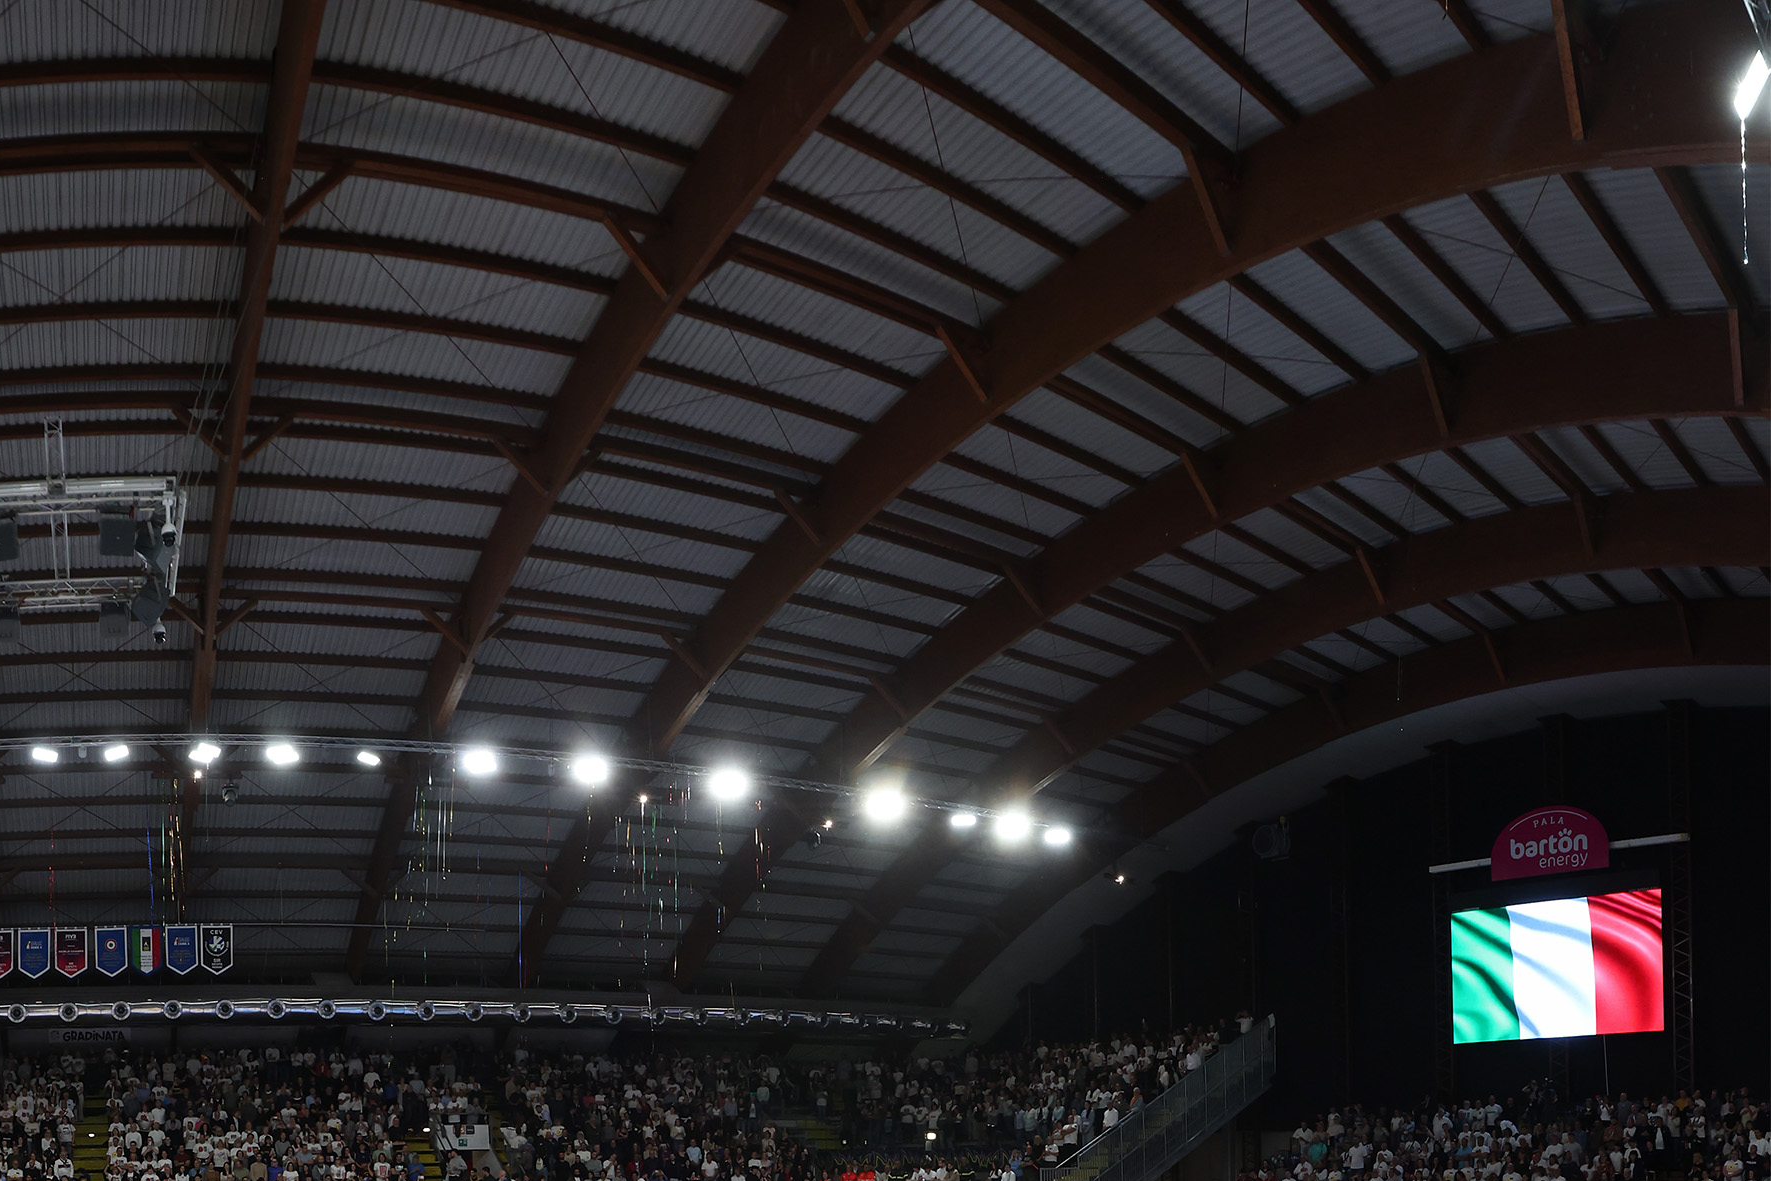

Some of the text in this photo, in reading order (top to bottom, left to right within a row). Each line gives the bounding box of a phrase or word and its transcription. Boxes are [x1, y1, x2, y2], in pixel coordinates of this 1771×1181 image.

[1533, 816, 1564, 828] PALA
[1510, 829, 1588, 859] barton
[1539, 852, 1588, 868] energy
